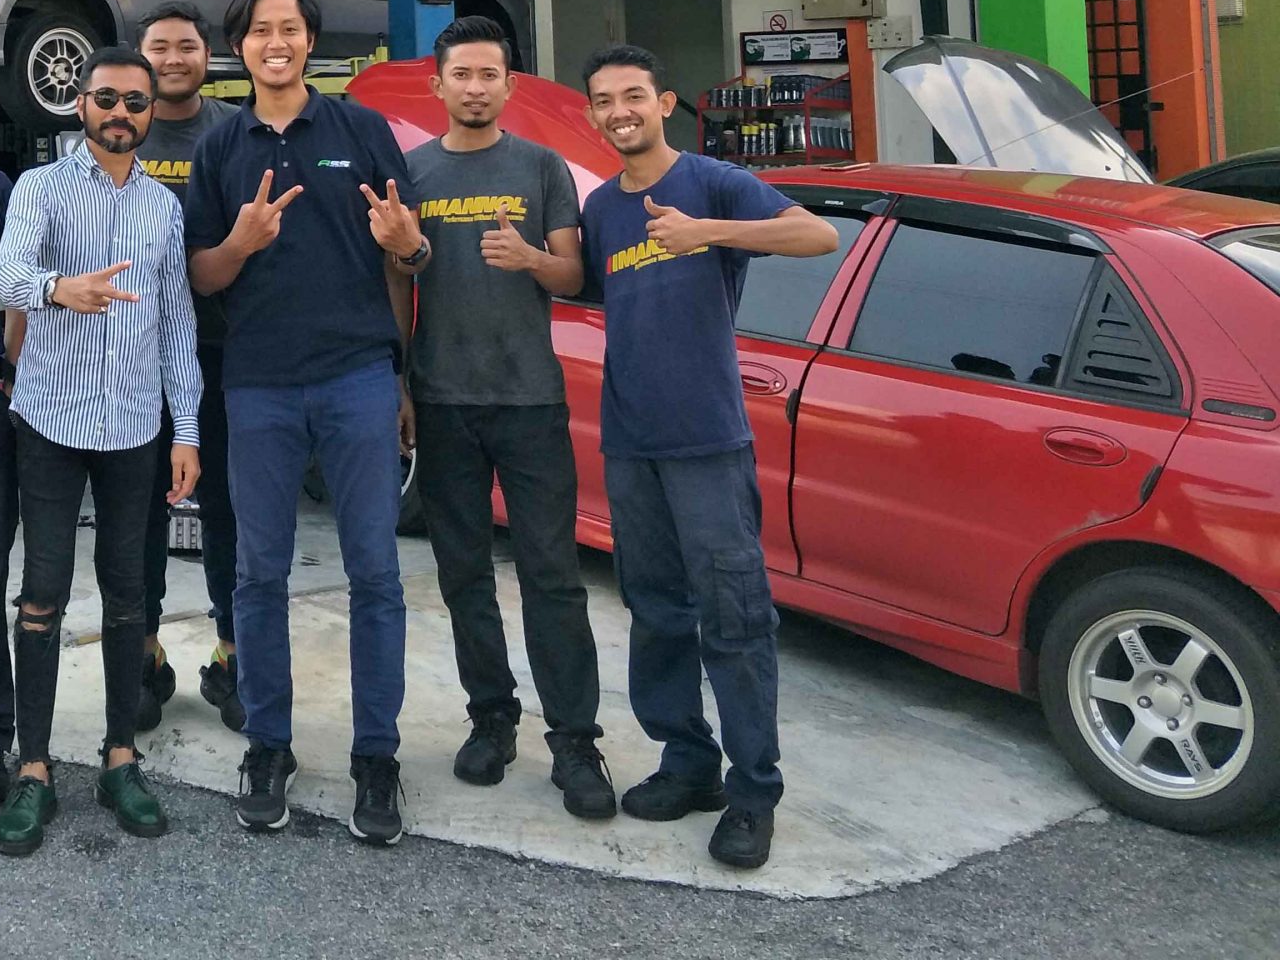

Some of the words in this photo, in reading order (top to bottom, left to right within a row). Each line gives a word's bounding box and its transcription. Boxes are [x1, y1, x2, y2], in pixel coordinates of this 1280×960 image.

[141, 160, 192, 177] MAN
[427, 196, 527, 218] MANNOL
[1181, 739, 1203, 772] RAYS
